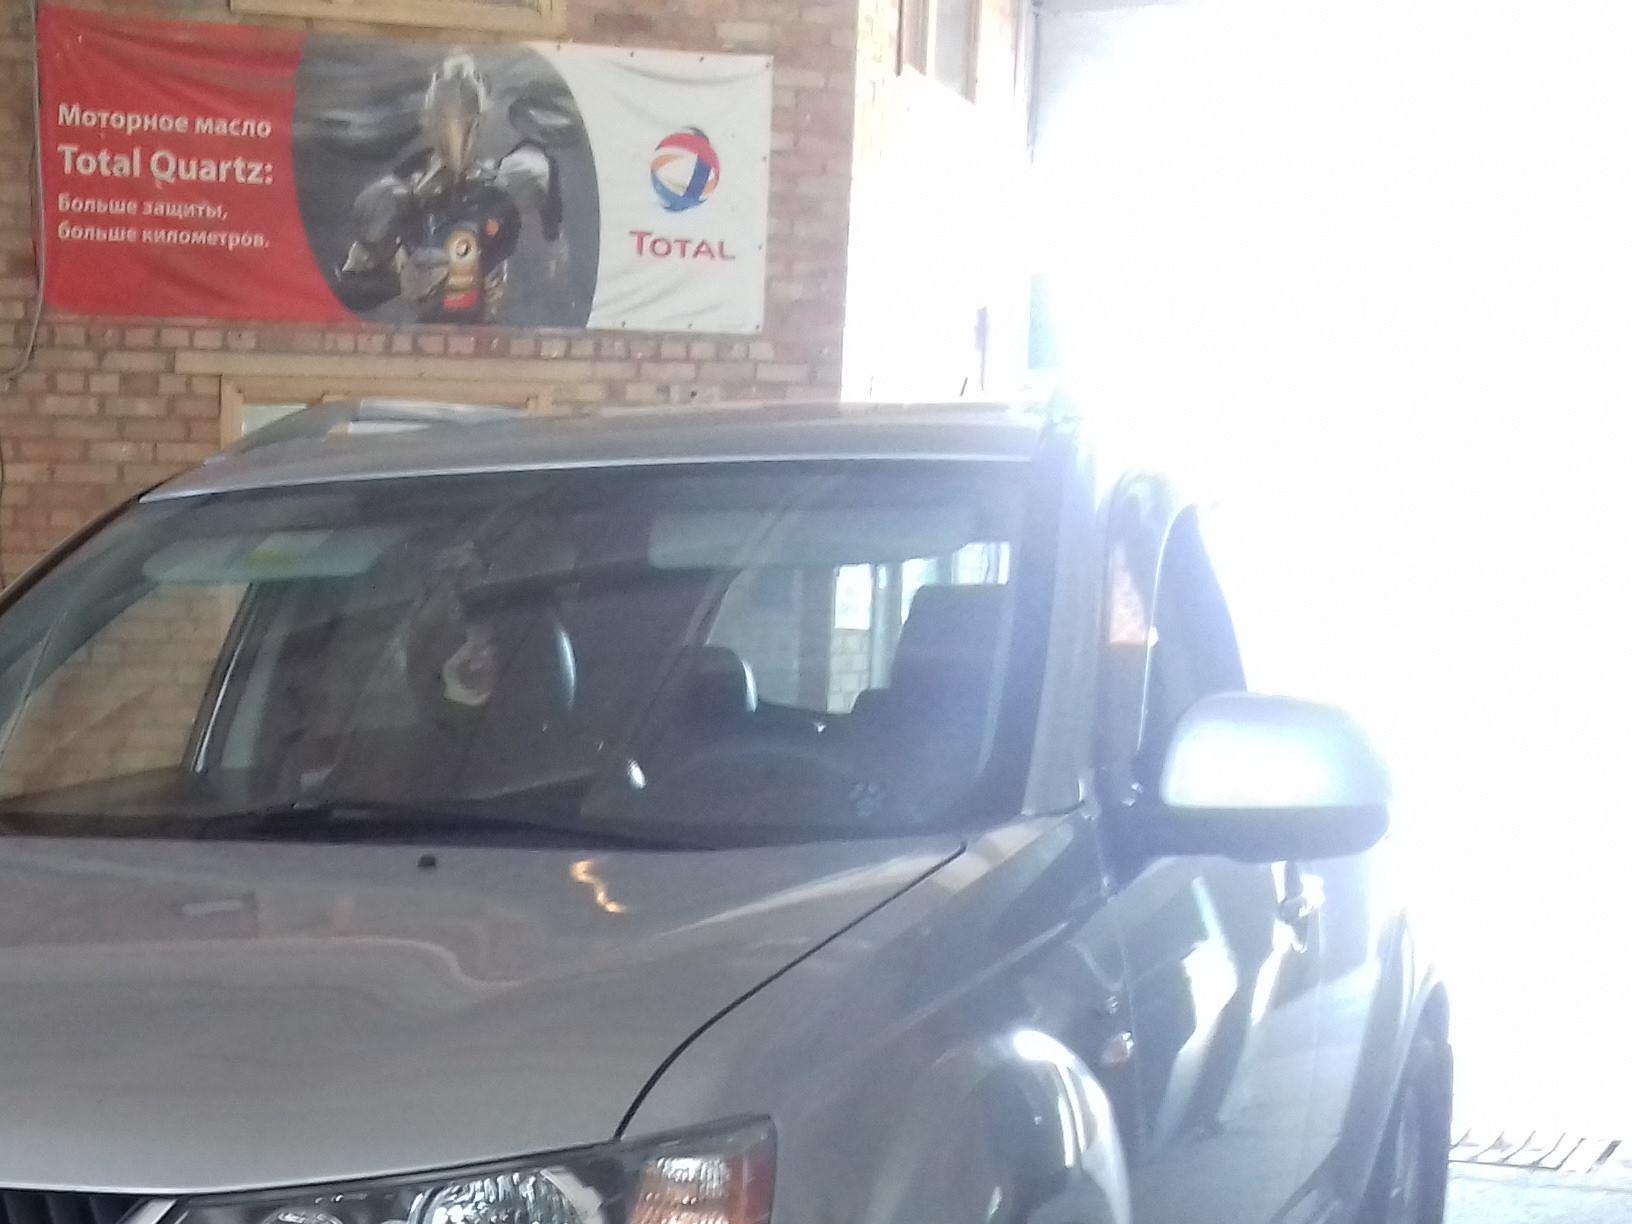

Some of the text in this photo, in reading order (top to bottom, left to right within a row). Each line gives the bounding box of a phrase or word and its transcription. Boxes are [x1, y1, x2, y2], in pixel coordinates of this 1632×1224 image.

[58, 102, 273, 139] Моторное масло
[57, 143, 274, 186] Total Quartz:
[57, 191, 228, 221] Больше защиты,
[57, 219, 271, 251] больше километров.
[628, 230, 737, 261] TOTAL
